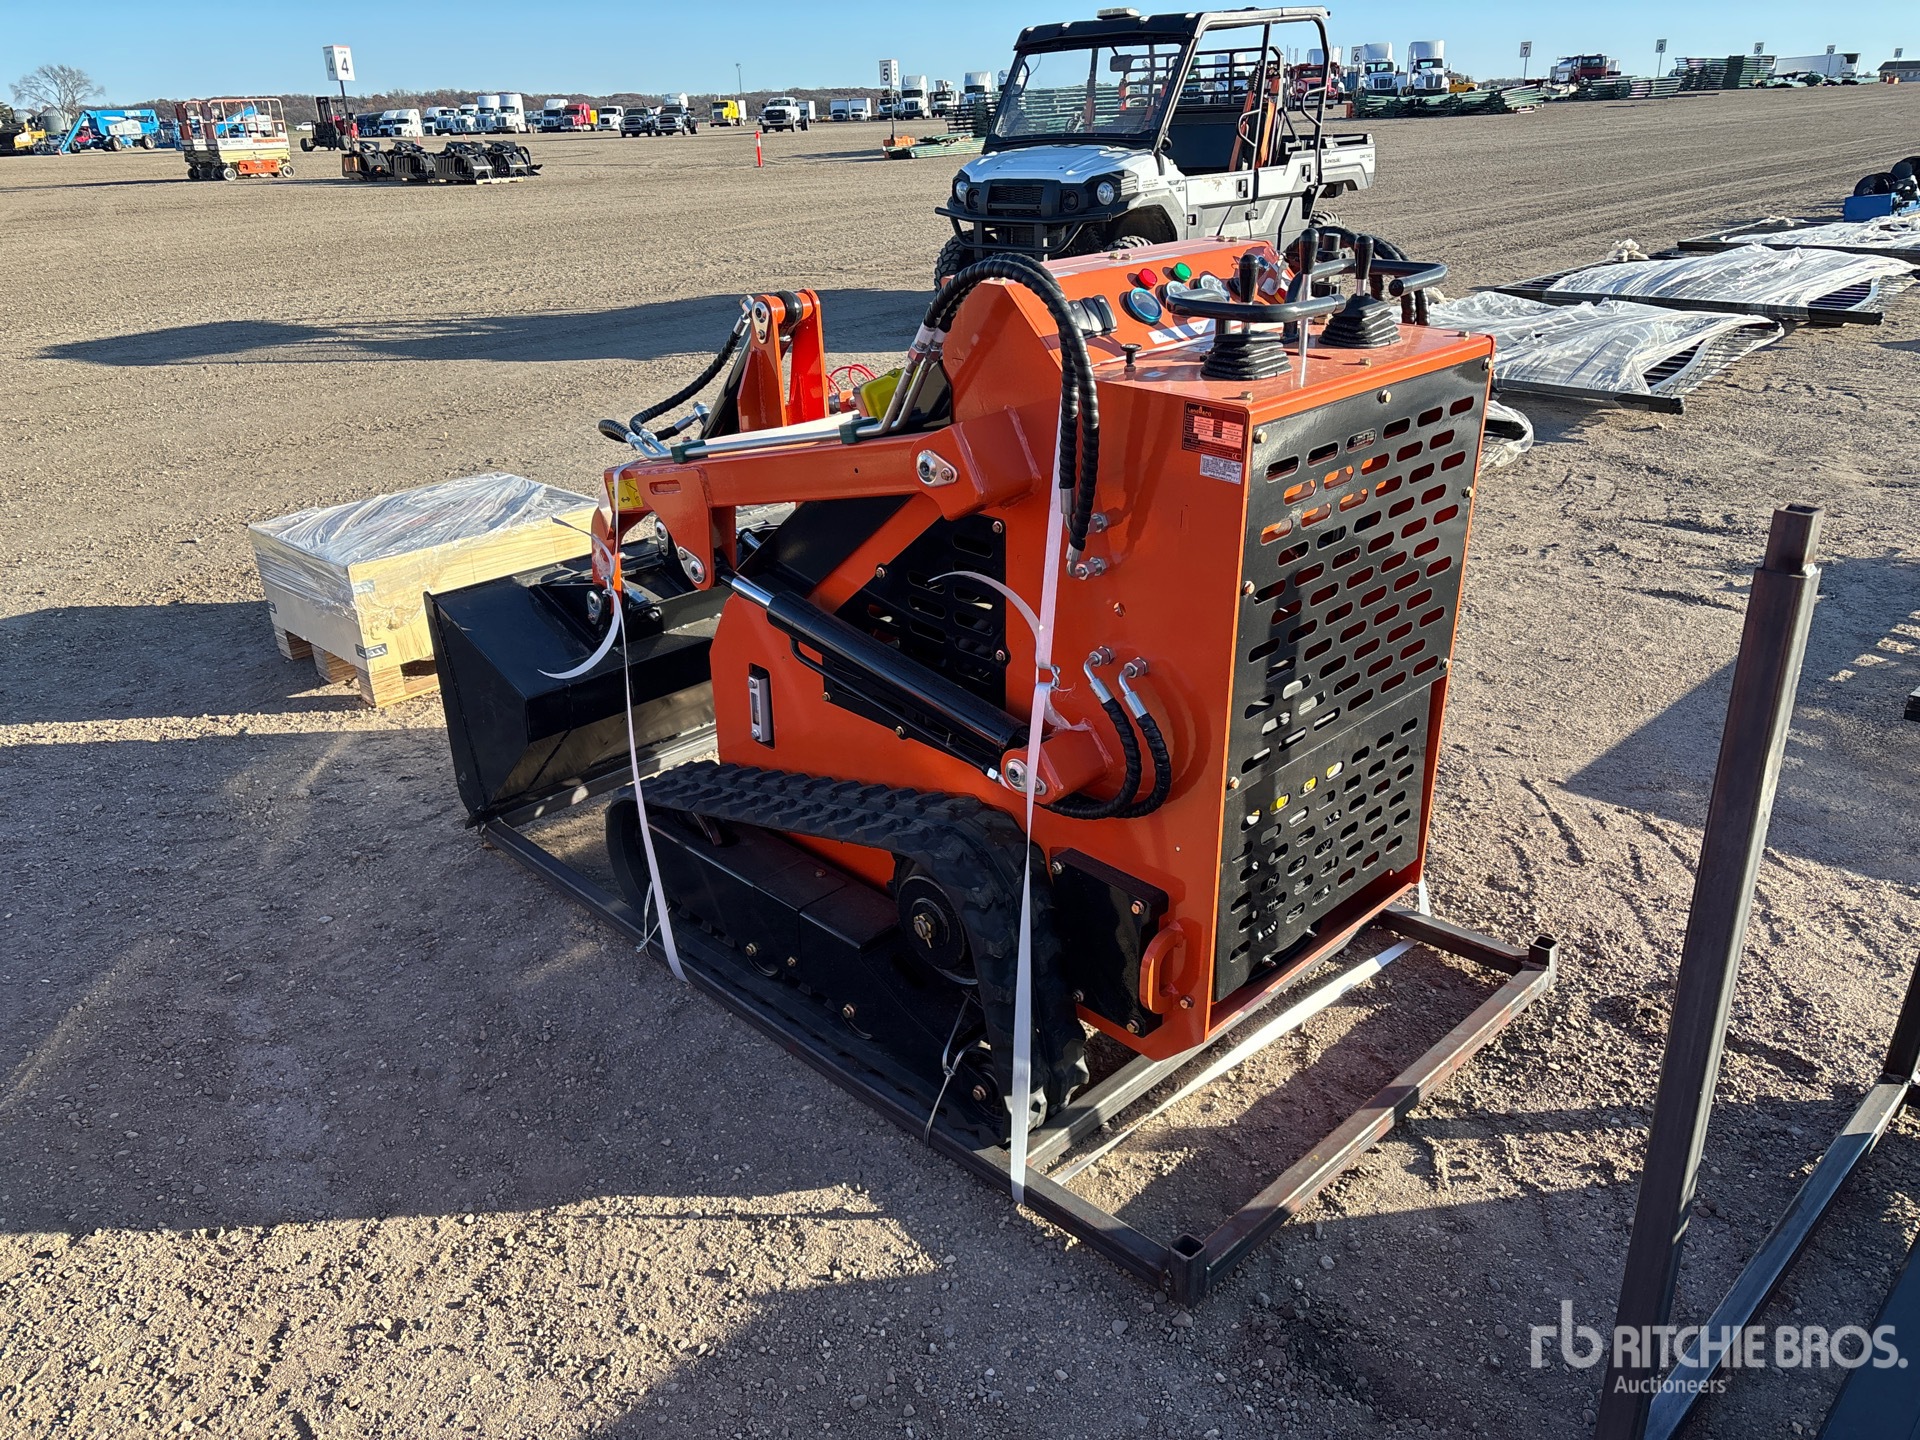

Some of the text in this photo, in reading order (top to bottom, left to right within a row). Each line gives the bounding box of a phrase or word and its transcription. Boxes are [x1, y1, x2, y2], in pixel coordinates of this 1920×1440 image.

[1353, 51, 1360, 62] 6
[1523, 46, 1529, 55] 7
[328, 57, 334, 75] 4
[341, 57, 349, 74] 4
[882, 67, 890, 82] 5
